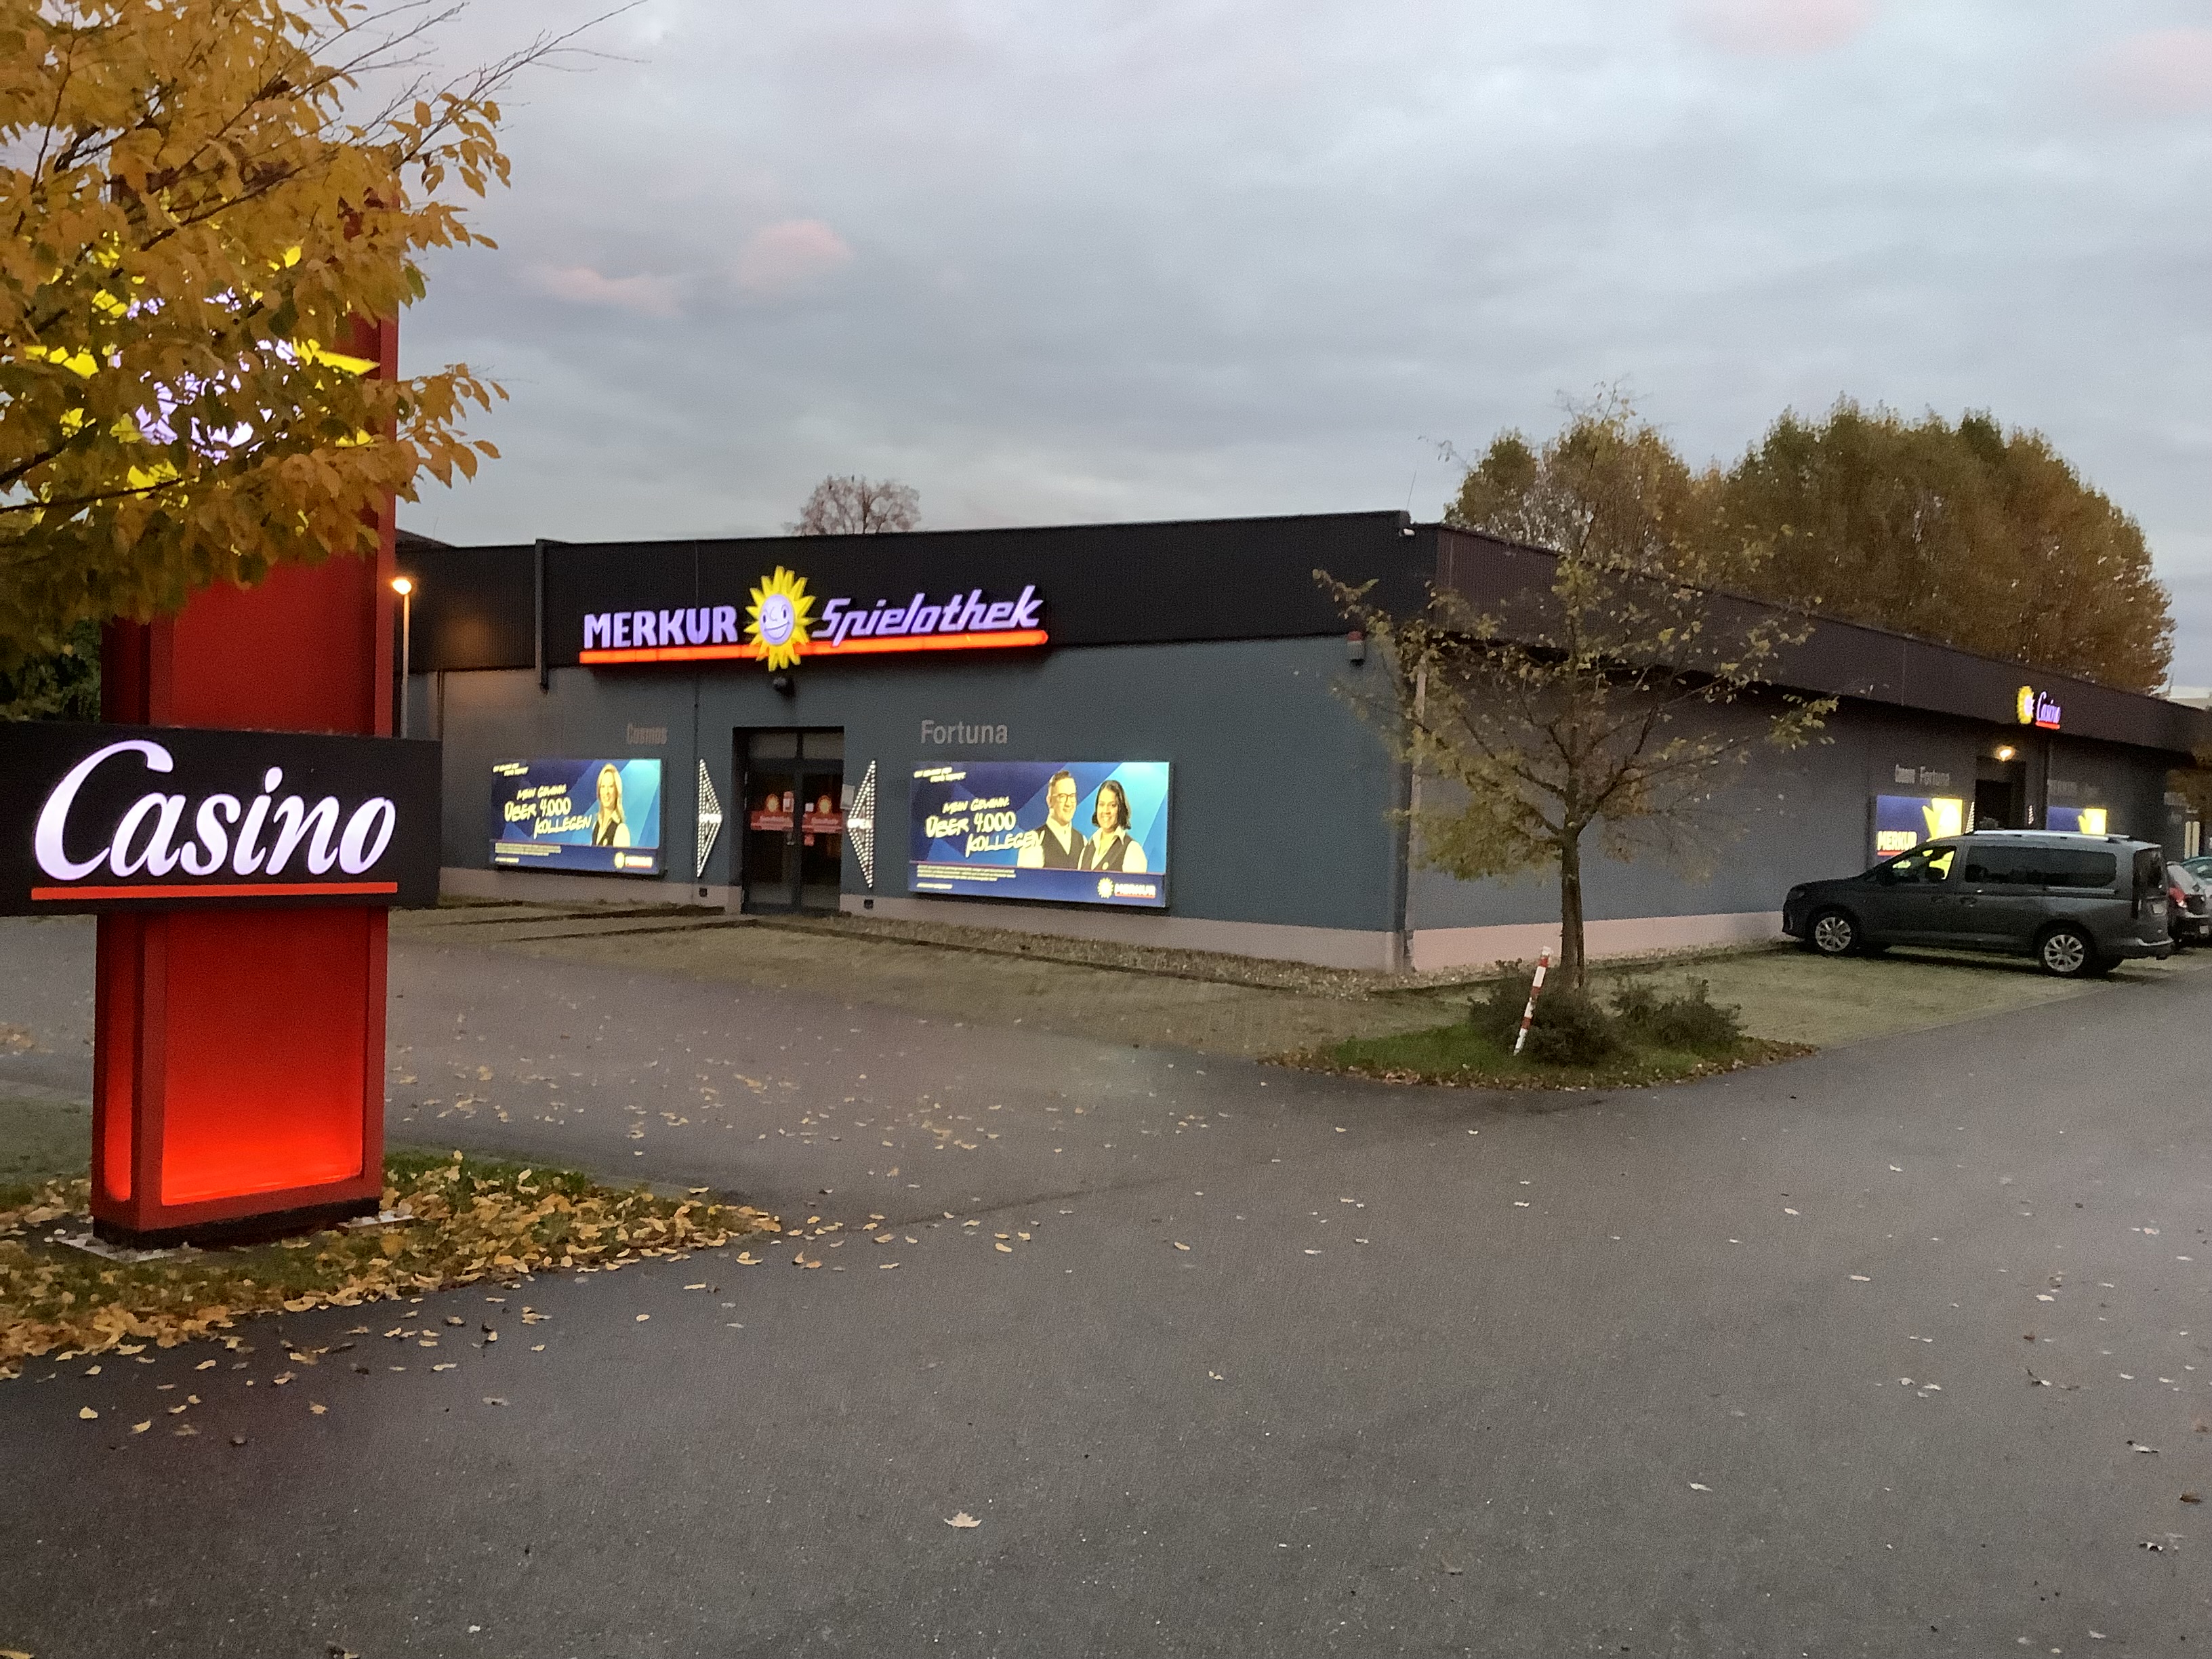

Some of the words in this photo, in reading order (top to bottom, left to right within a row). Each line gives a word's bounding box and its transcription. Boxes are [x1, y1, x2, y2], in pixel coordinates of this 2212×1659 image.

[584, 606, 738, 649] MERKUR
[811, 585, 1044, 647] Spielothek
[920, 719, 1008, 744] Fortuna
[35, 739, 396, 881] Casino
[942, 800, 968, 815] MEIN
[533, 815, 592, 840] KOLLEGEN
[973, 811, 1017, 833] 4.000
[965, 830, 1045, 858] KOLLEGEN
[1877, 831, 1917, 851] MERKUR
